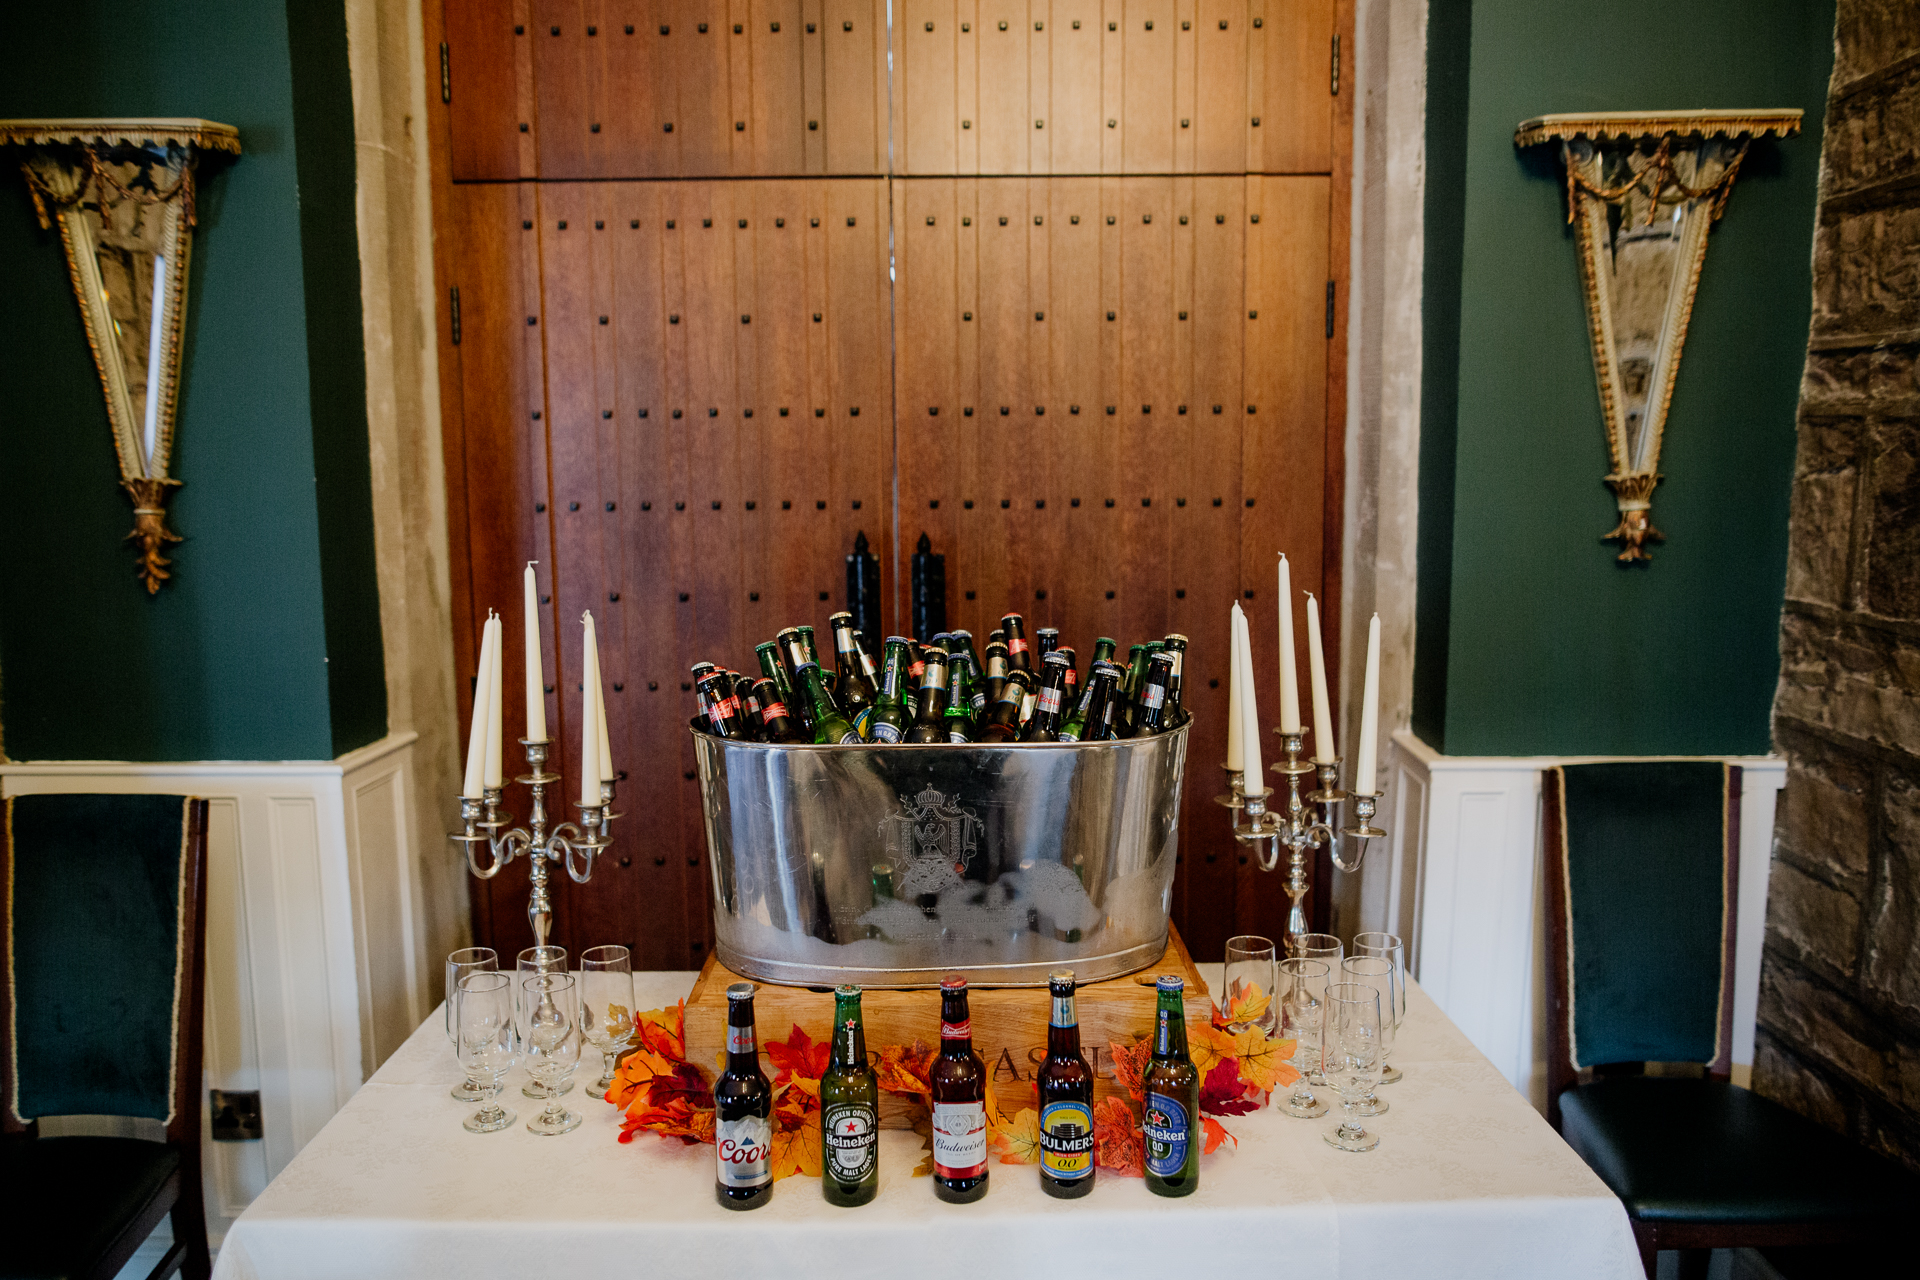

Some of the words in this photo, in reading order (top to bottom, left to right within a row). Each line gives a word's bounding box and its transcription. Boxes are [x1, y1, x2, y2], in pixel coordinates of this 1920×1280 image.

[1038, 693, 1060, 706] Coors
[847, 1029, 855, 1065] Heineken
[828, 1111, 851, 1129] HEINEKEN
[852, 1109, 873, 1127] ORIGINAL
[825, 1132, 875, 1148] Heineken
[935, 1137, 985, 1152] Budweiser
[1039, 1130, 1094, 1151] BULMERS
[830, 1157, 842, 1173] PURE
[842, 1168, 859, 1177] MALT
[859, 1154, 873, 1173] LAGER
